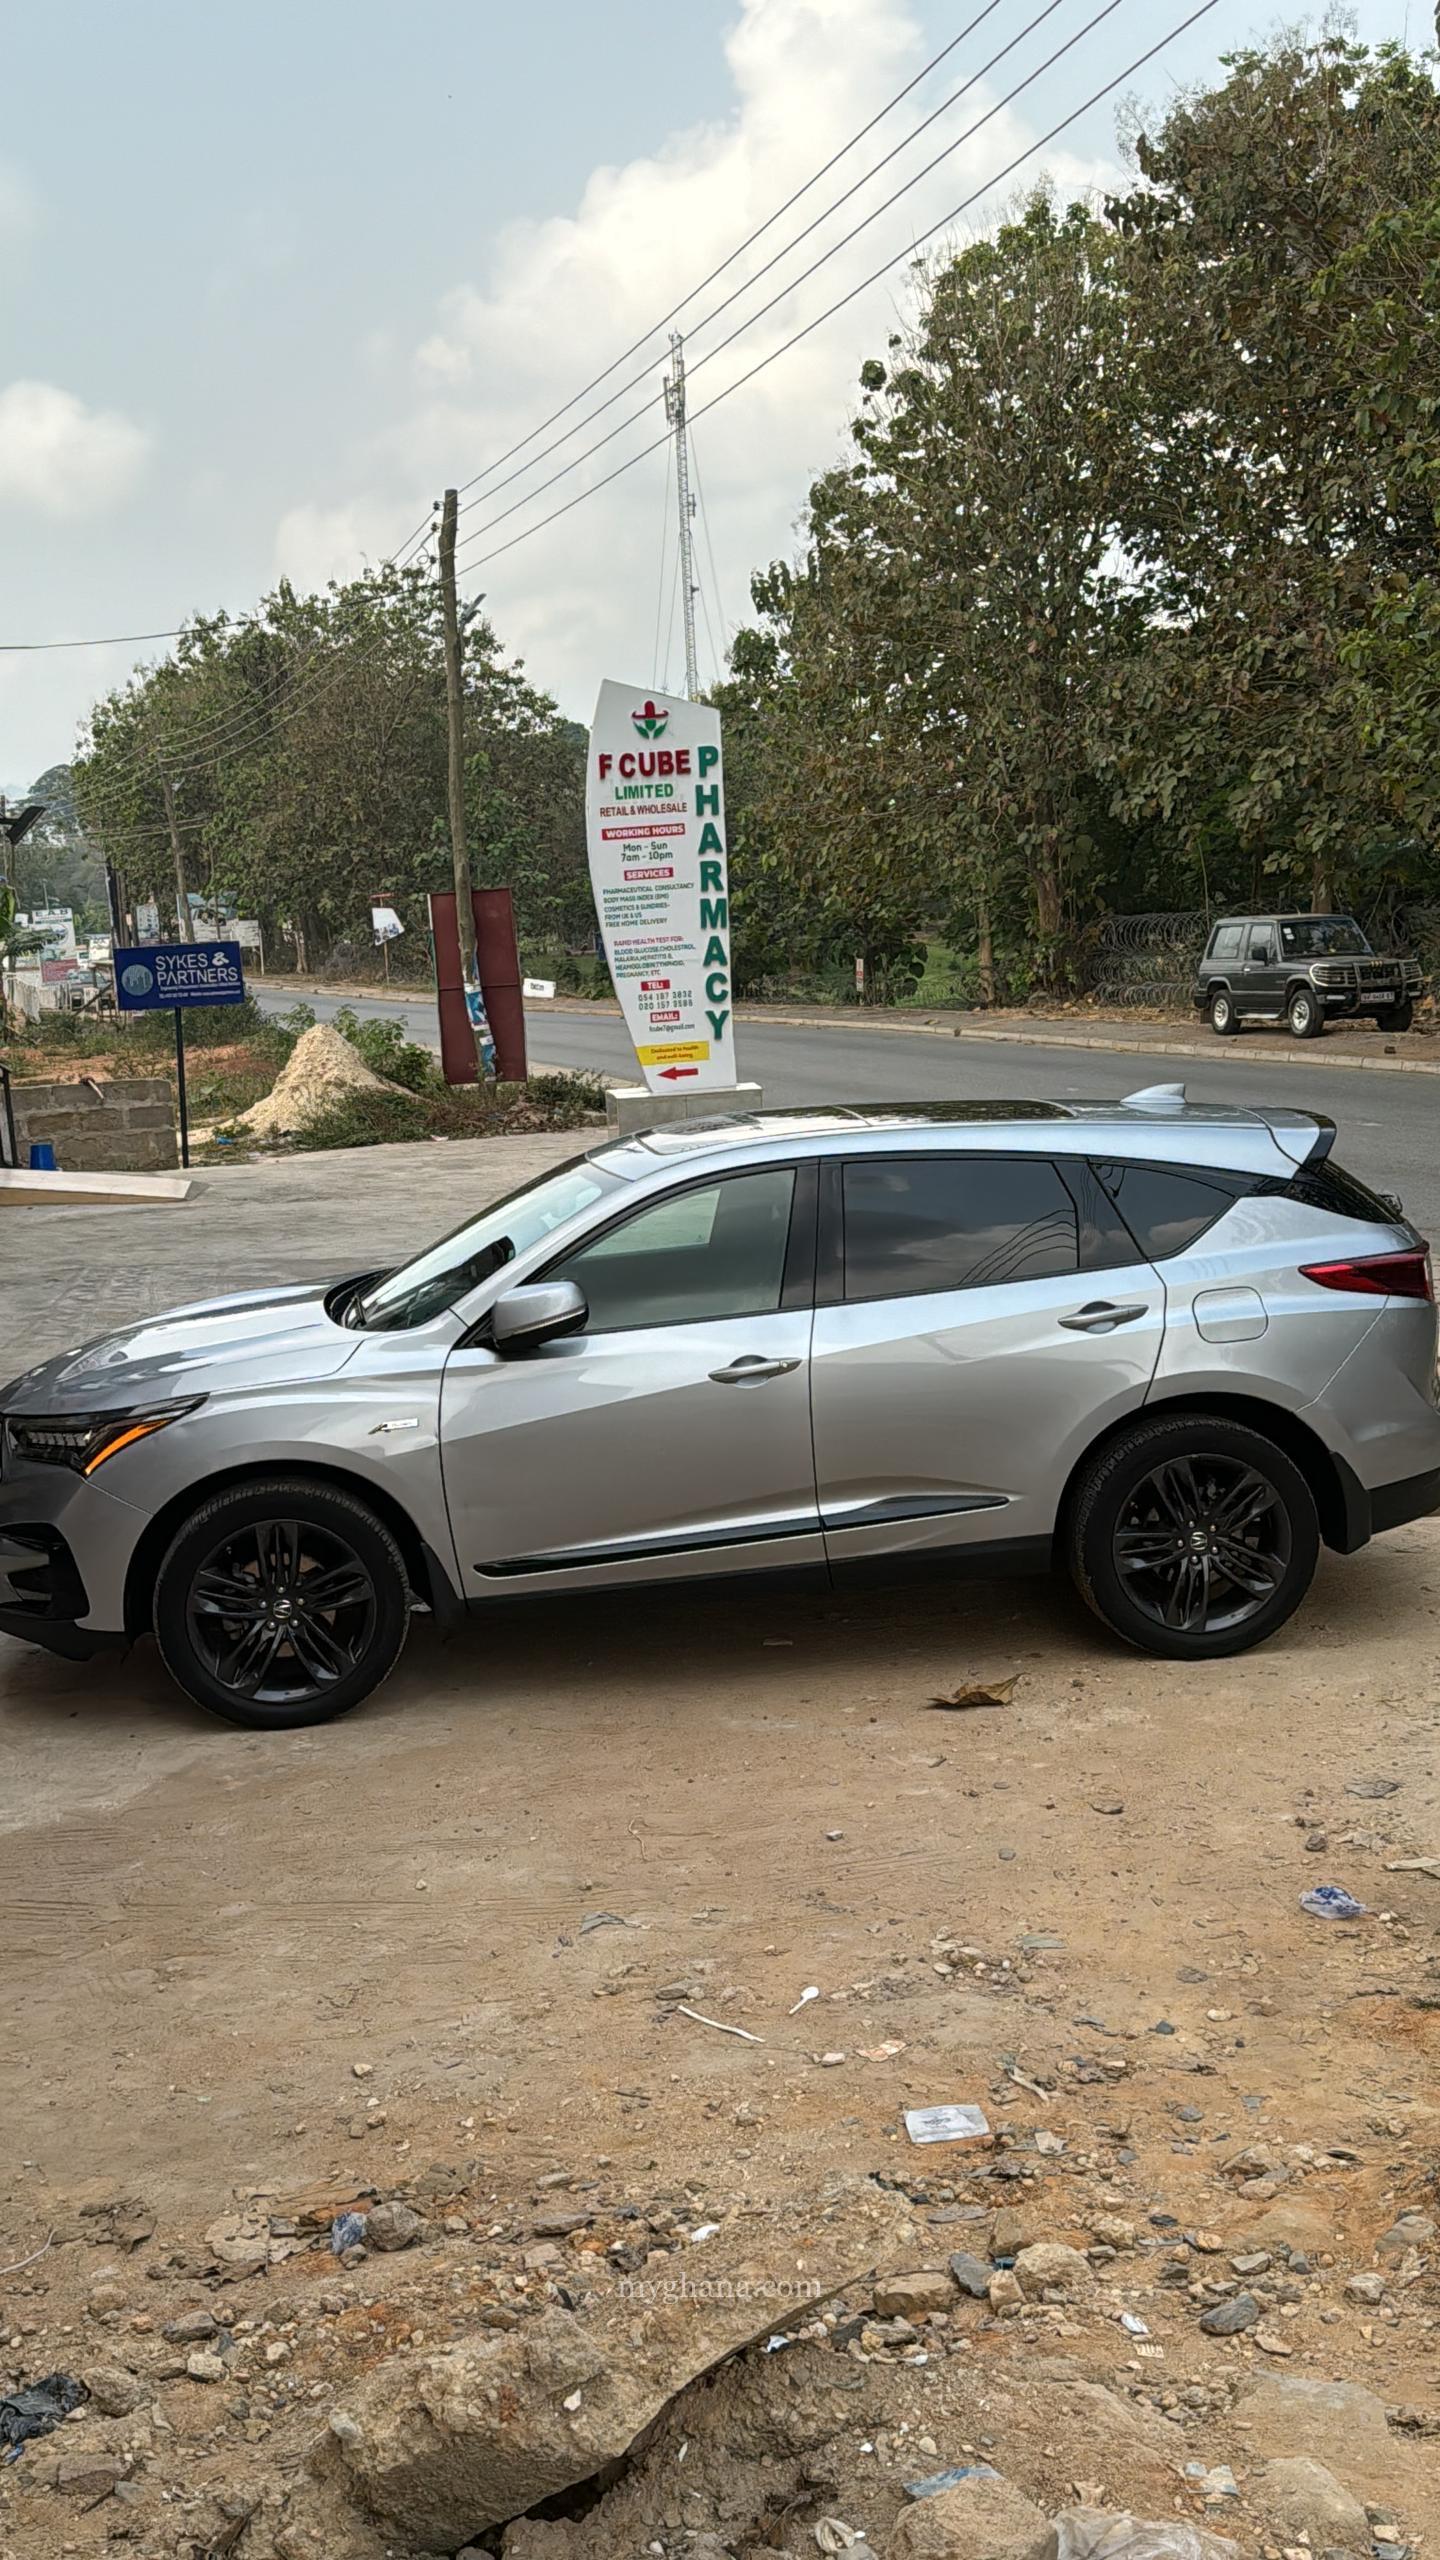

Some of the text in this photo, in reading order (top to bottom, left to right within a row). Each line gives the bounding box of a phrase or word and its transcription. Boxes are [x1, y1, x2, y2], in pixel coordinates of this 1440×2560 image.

[599, 749, 691, 780] F CUBE
[615, 783, 674, 801] LIMITED
[600, 802, 688, 817] RETAIL & WHOLESALE
[606, 824, 684, 838] WORKING HOURS
[623, 843, 642, 852] Mon
[651, 841, 668, 850] Sun
[621, 853, 640, 862] 7am
[649, 851, 674, 862] 10pm
[626, 868, 671, 879] SERVICES
[603, 883, 694, 895] PHARMACEUTICAL CONSULTANCY
[695, 746, 730, 1041] PHARMACY
[604, 905, 635, 913] COSMETICS
[639, 918, 667, 926] DELIVERY
[155, 951, 230, 970] SYKES &
[157, 967, 238, 986] PARTNERS
[647, 982, 664, 990] TEL:
[652, 1012, 678, 1021] EMAIL:
